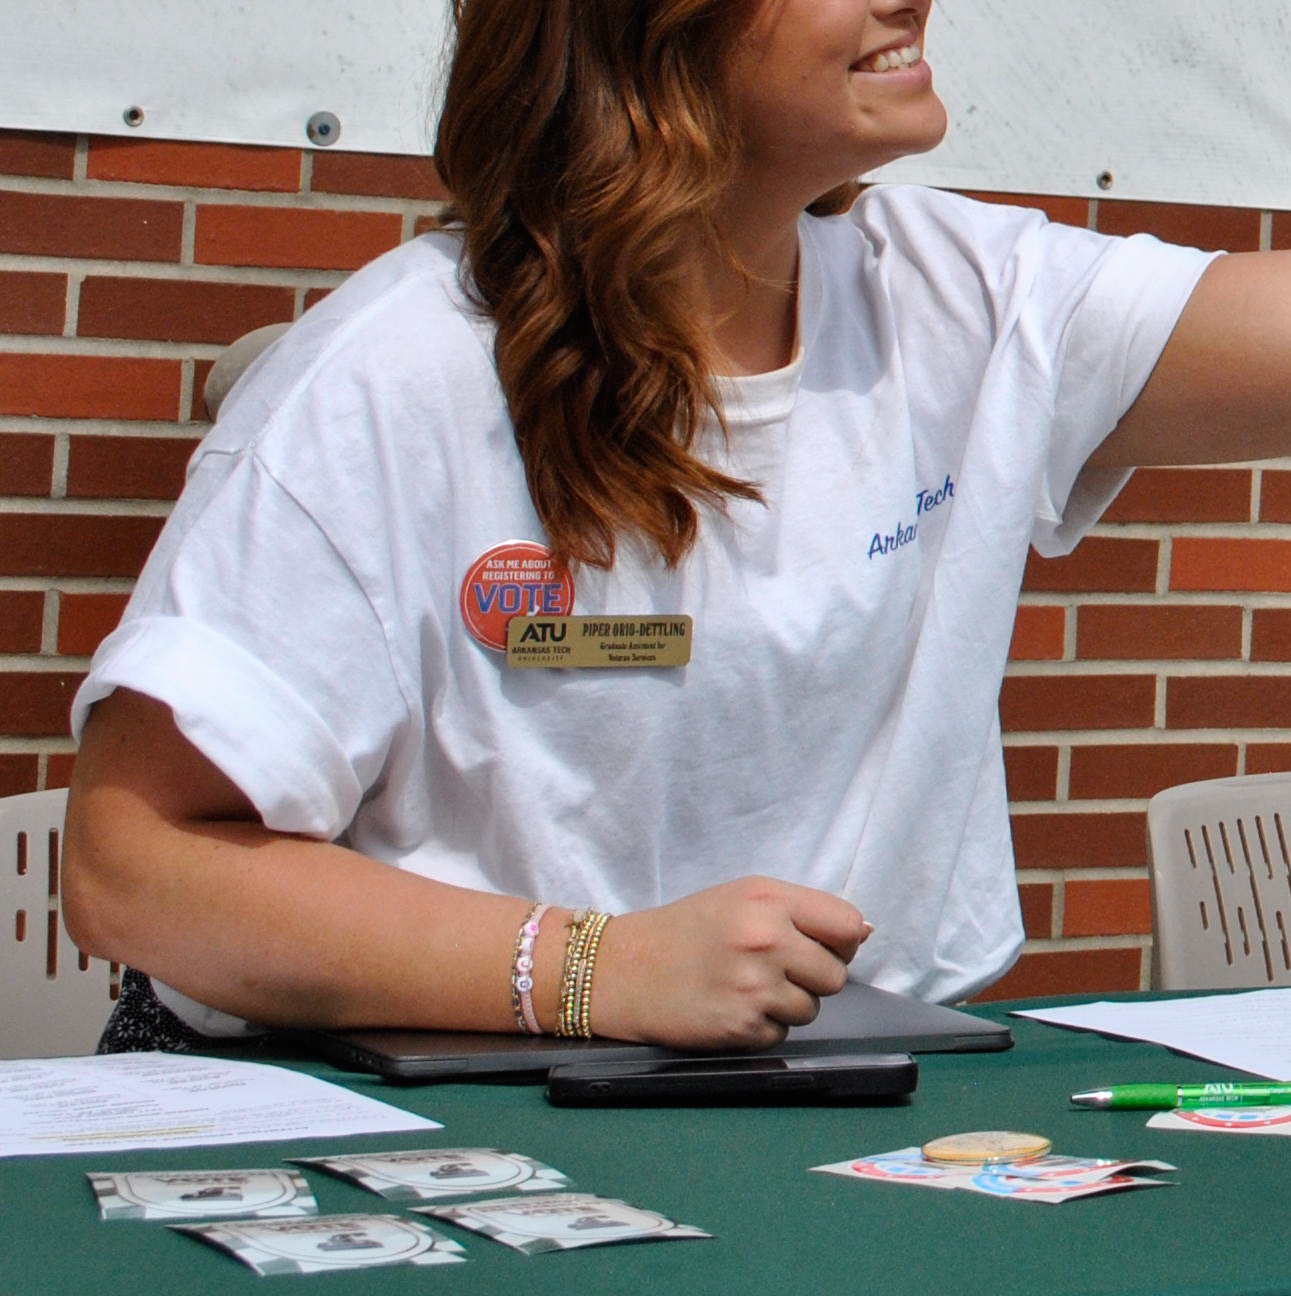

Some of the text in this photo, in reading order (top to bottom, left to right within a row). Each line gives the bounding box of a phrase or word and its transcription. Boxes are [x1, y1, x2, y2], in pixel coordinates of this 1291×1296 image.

[915, 473, 954, 517] Tech
[486, 559, 551, 569] ASK ME ABOUT
[483, 570, 555, 580] REGISTERING TO
[473, 583, 563, 614] VOTE
[520, 622, 567, 643] ATU
[582, 622, 610, 637] PIPER
[512, 646, 571, 655] ARKANSAS TECH
